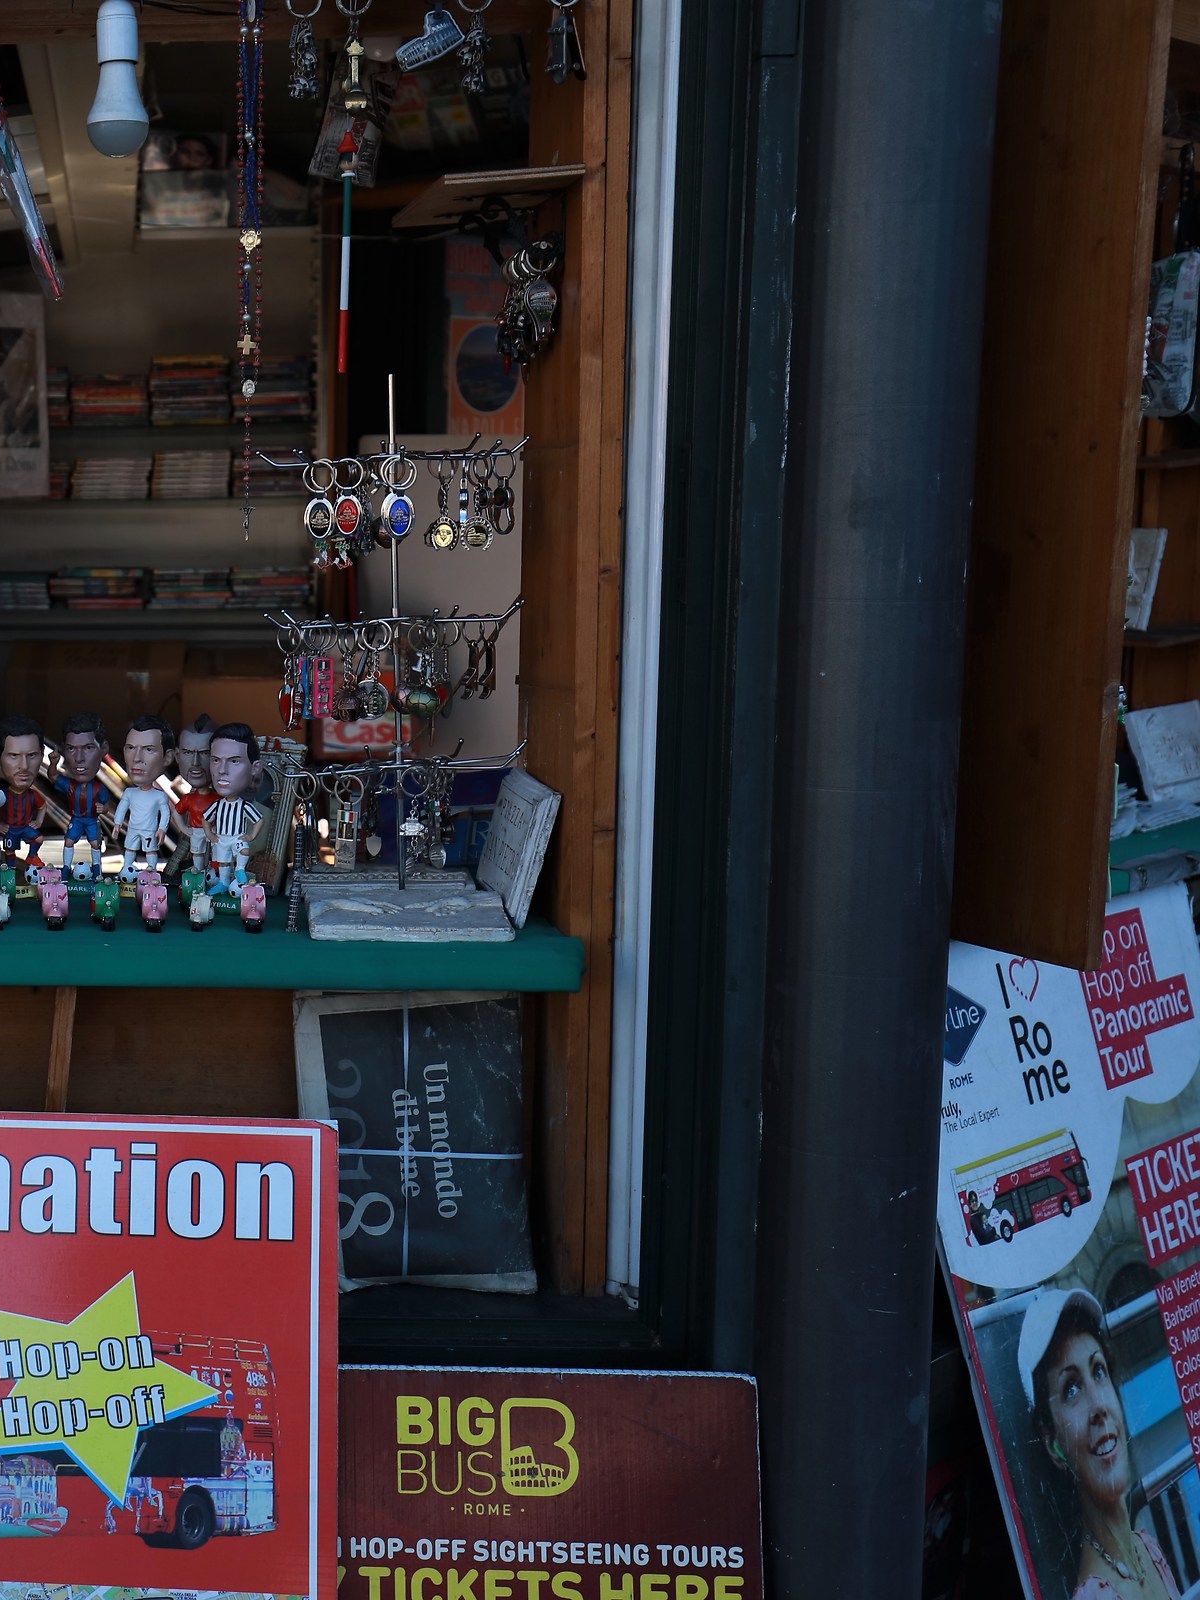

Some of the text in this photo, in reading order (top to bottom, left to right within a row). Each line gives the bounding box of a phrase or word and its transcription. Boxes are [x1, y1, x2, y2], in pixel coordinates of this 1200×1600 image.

[3, 837, 13, 849] 10
[145, 836, 152, 849] 7
[1119, 921, 1144, 949] on
[995, 962, 1011, 1009] I
[1082, 951, 1152, 1002] Hop off
[1091, 983, 1190, 1042] Panoramic
[1009, 1014, 1053, 1064] Ro
[1099, 1043, 1146, 1081] Tour
[949, 1072, 974, 1090] ROME
[1022, 1058, 1071, 1106] me
[391, 1088, 420, 1119] di
[944, 1107, 1000, 1134] The Local Expert
[423, 1060, 464, 1220] Un mondo
[1157, 1269, 1200, 1305] Via Venet
[1169, 1335, 1183, 1355] St.
[0, 1384, 167, 1438] Hop-off
[395, 1394, 496, 1446] BIG
[395, 1448, 498, 1498] BUS
[464, 1503, 513, 1517] ROME
[350, 1537, 745, 1569] HOP-OFF SIGHTSEEING TOURS
[358, 1565, 746, 1600] TICKETS HERE
